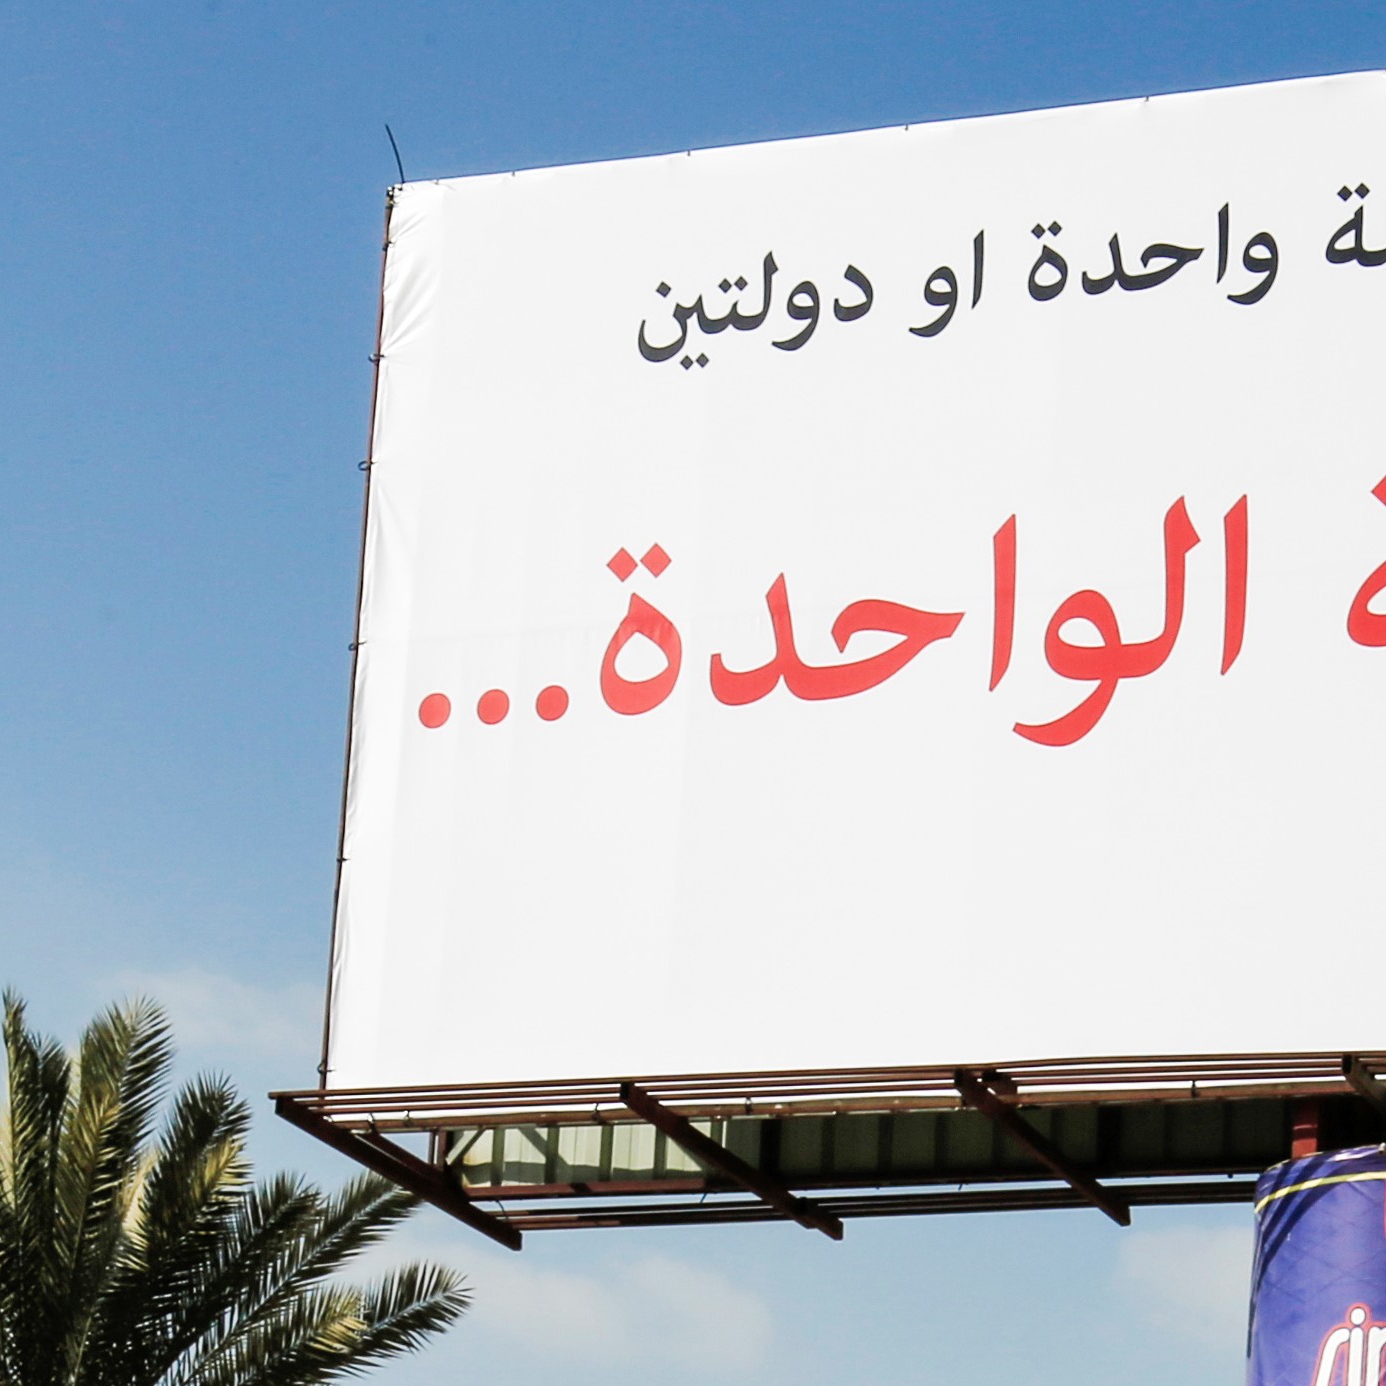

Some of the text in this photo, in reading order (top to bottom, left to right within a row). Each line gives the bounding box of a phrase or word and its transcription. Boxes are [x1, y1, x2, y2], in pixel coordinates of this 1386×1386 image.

[909, 230, 984, 337] او
[1028, 203, 1278, 305] واحدة
[638, 252, 873, 369] دولتين
